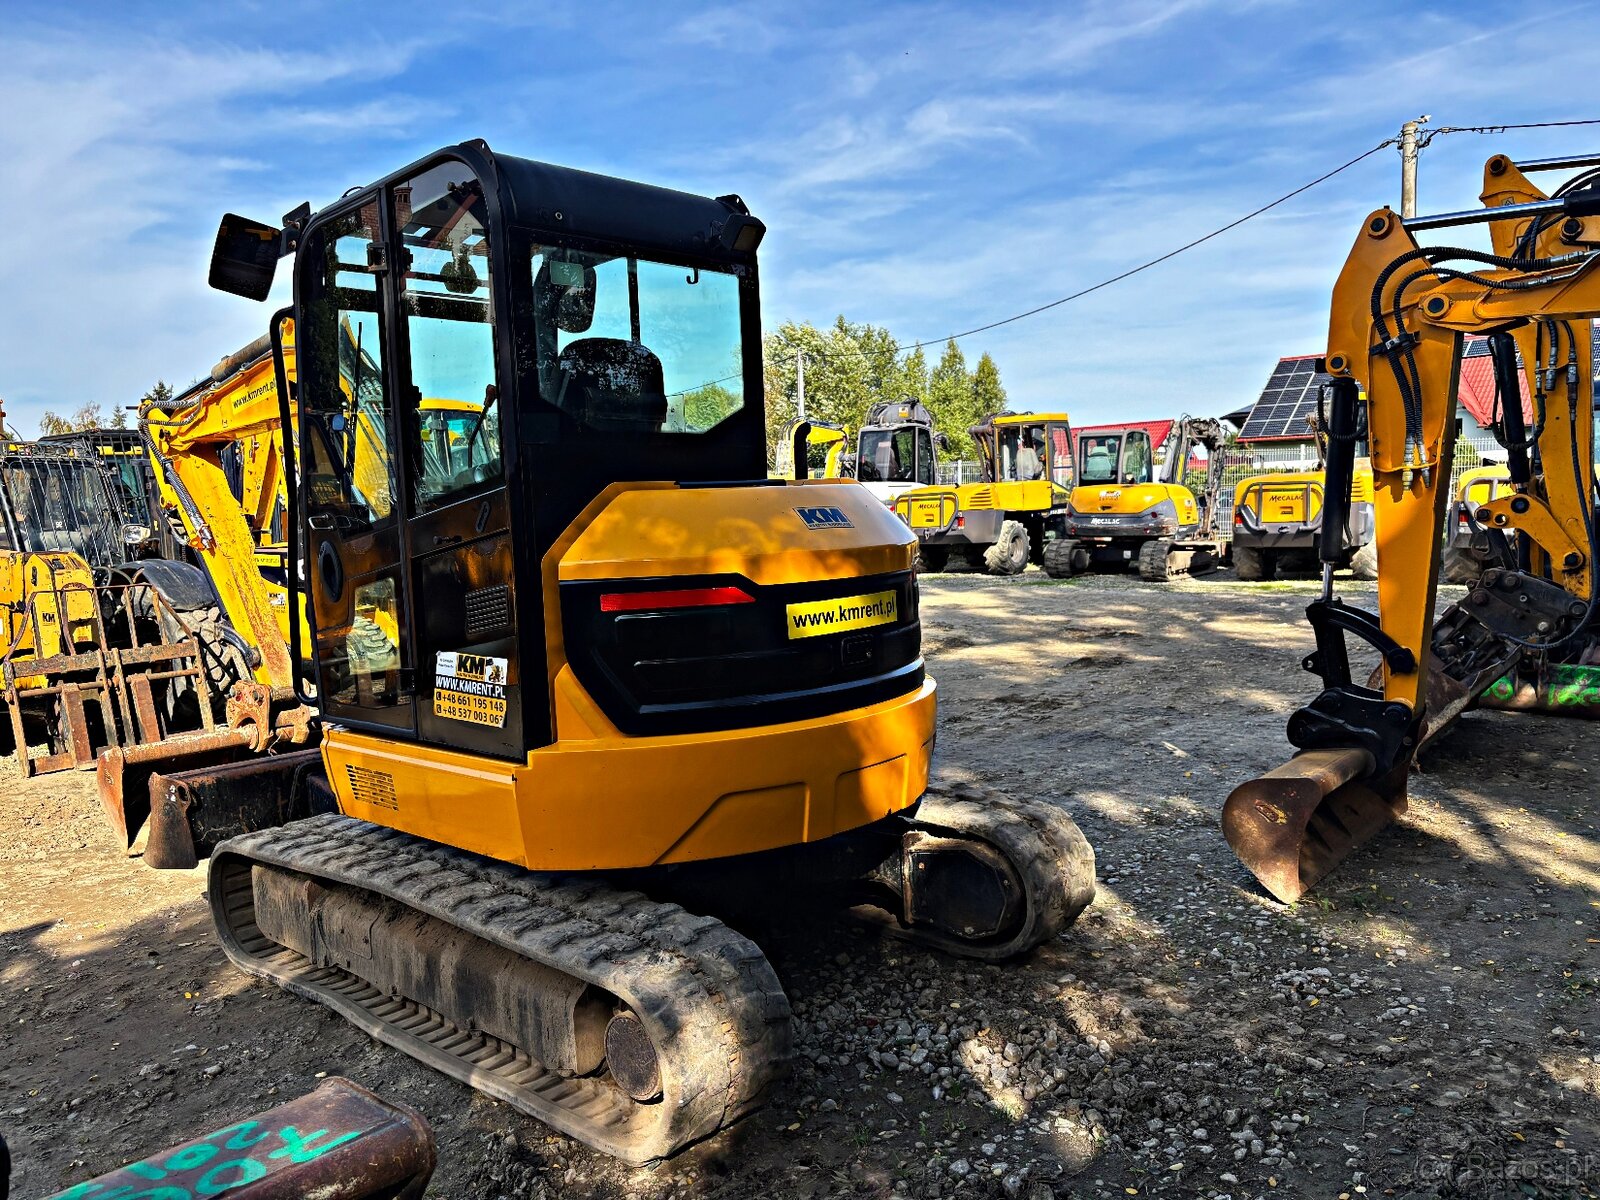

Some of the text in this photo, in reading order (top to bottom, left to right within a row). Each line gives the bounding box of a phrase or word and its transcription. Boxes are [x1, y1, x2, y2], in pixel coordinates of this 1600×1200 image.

[798, 508, 847, 523] KM
[793, 597, 894, 628] www.kmrent.pl
[457, 655, 485, 675] KM
[435, 675, 506, 699] WWW.KMRENT.PL
[443, 693, 504, 713] +48 661 195 148
[458, 707, 472, 719] 537
[473, 710, 488, 722] 003
